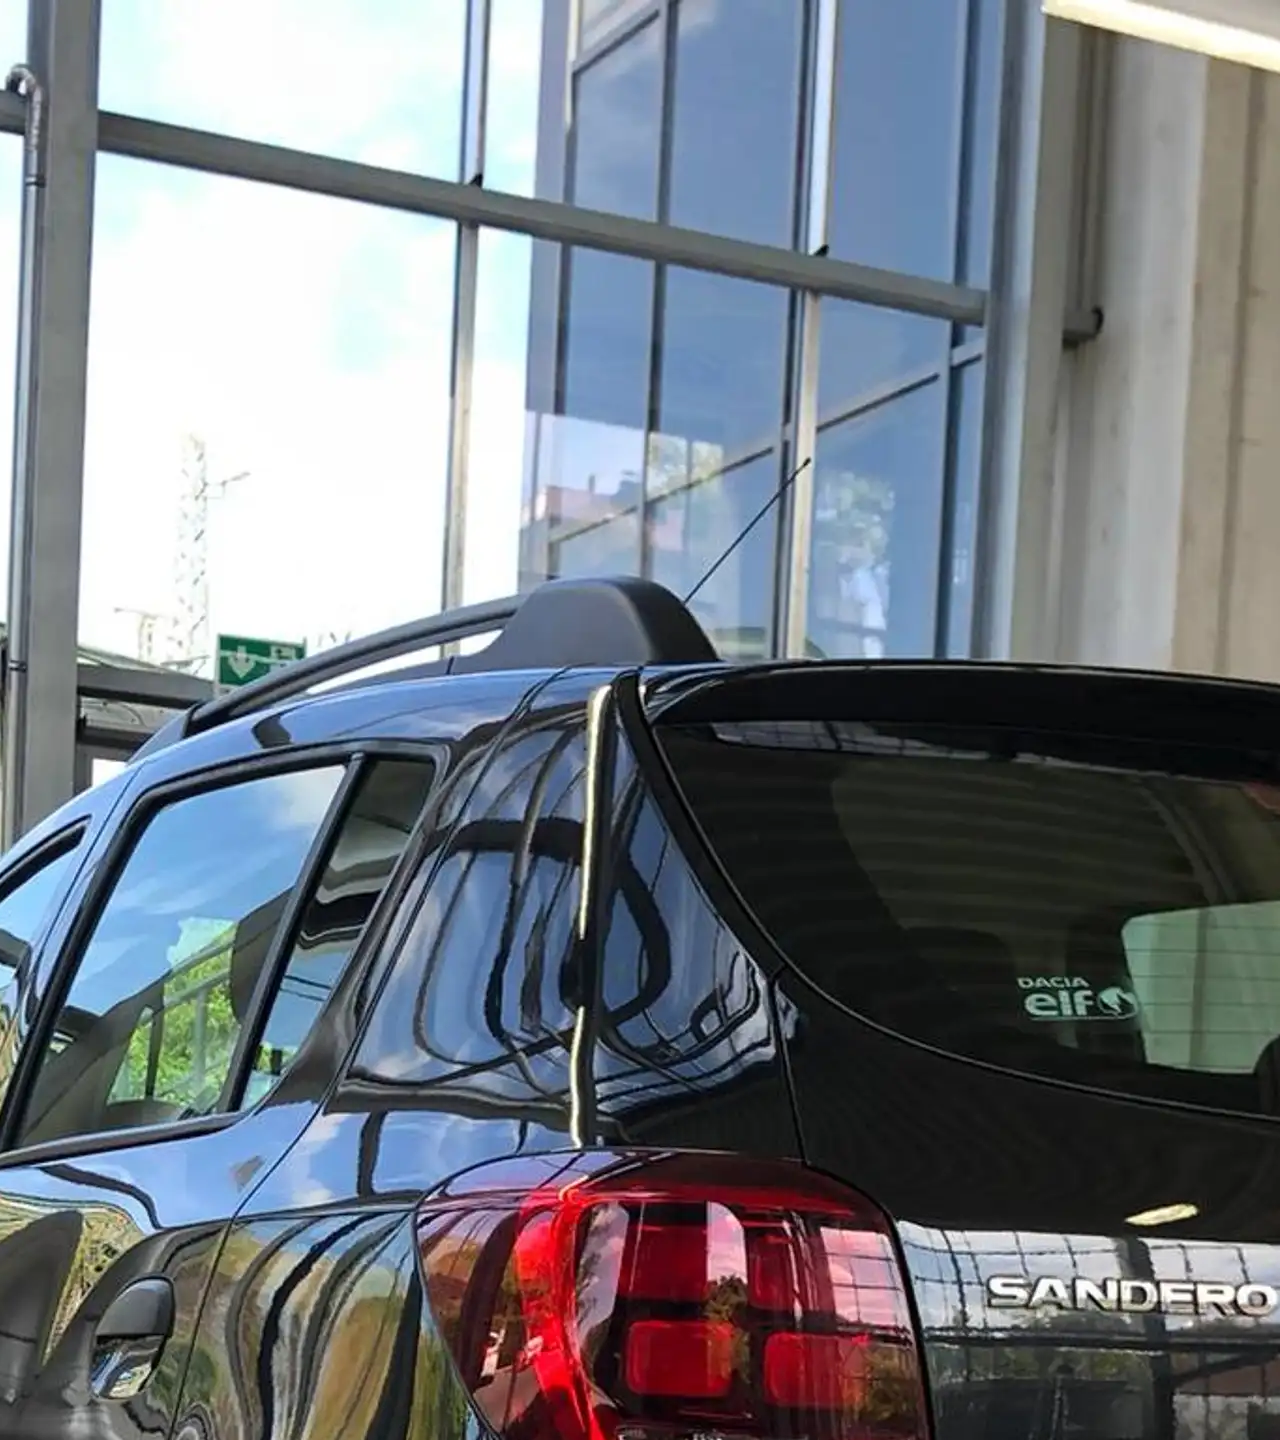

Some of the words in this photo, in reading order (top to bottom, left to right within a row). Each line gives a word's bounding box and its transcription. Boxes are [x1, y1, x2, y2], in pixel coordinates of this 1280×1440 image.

[1017, 976, 1090, 989] DACIA
[1024, 989, 1094, 1016] elf
[987, 1274, 1279, 1316] SANDERO
